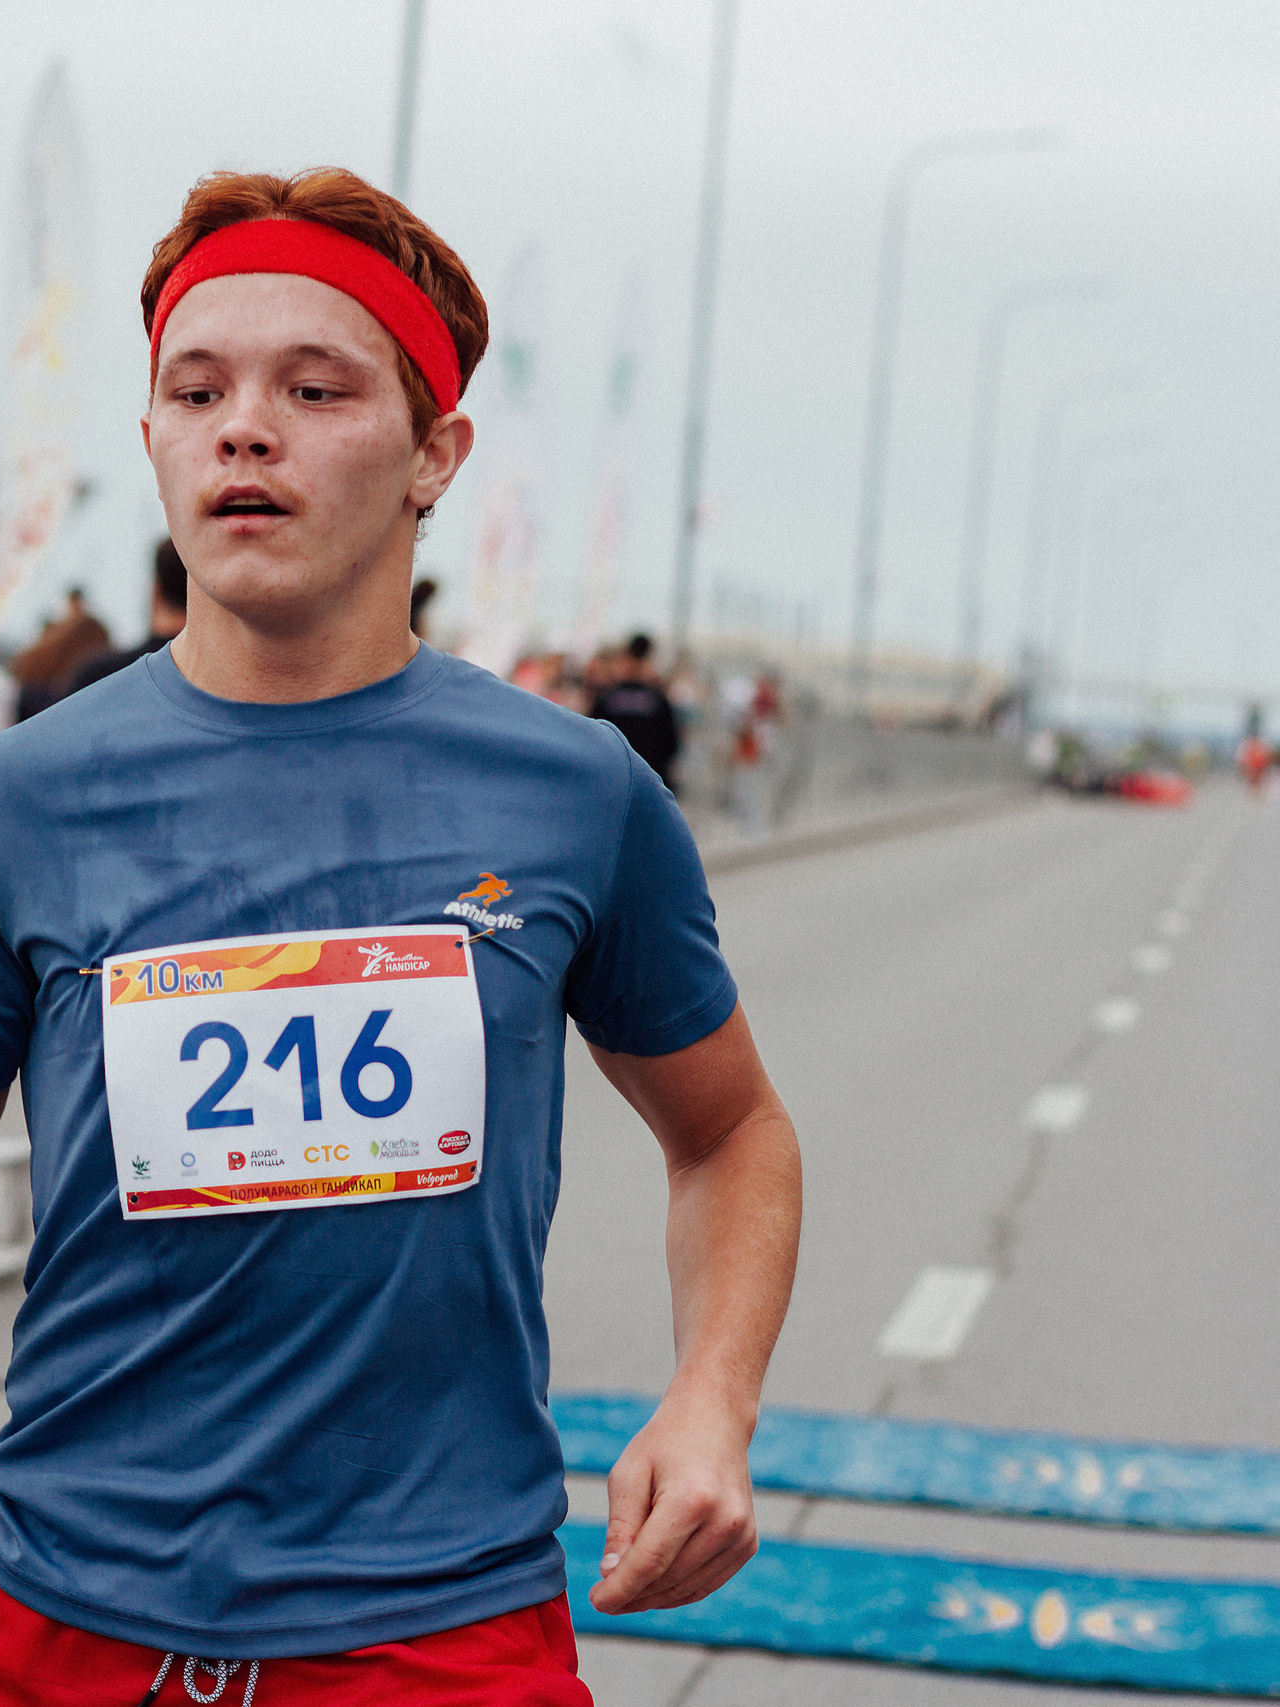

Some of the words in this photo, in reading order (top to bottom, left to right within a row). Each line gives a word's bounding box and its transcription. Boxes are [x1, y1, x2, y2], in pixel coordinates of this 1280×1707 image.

[443, 901, 524, 930] Athletic
[385, 961, 430, 972] HANDICAP
[136, 960, 180, 996] 10
[179, 1009, 413, 1131] 216
[250, 1149, 278, 1159] ДОДО
[250, 1159, 285, 1167] ПИЦЦА
[303, 1144, 350, 1164] СТС
[416, 1168, 459, 1188] Volgograd
[229, 1183, 318, 1201] ПОЛУМАРАФОН
[321, 1178, 382, 1194] ГАНДИКАП
